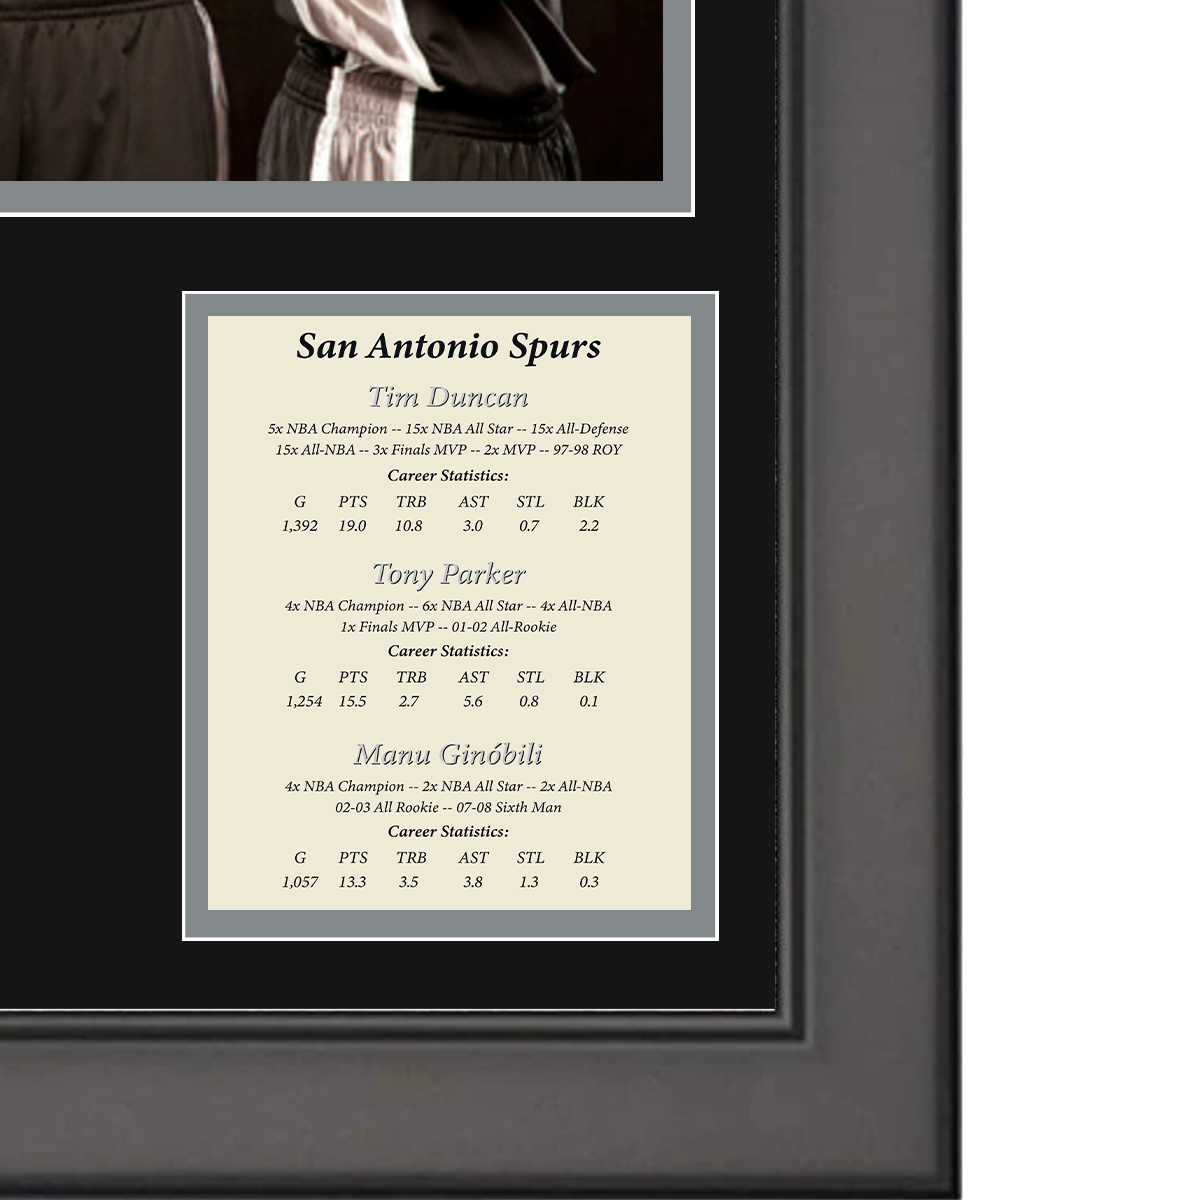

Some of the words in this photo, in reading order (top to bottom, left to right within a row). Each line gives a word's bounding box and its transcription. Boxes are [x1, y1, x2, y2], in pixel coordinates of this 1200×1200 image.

[296, 331, 359, 360] San
[363, 332, 499, 359] Antonio
[508, 331, 602, 368] Spurs
[369, 385, 420, 408] Tim
[426, 386, 529, 409] Duncan
[267, 423, 284, 436] 5x
[285, 422, 318, 435] NBA
[321, 421, 388, 439] Champion
[405, 423, 429, 436] 15x
[430, 422, 463, 435] NBA
[464, 421, 485, 435] All
[486, 422, 515, 435] Star
[530, 423, 554, 436] 15x
[555, 421, 630, 439] All-Defense
[275, 444, 299, 456] 15x
[300, 442, 356, 457] All-NBA
[372, 443, 389, 456] 3x
[390, 442, 431, 456] Finals
[432, 443, 468, 457] MVP
[483, 443, 500, 456] 2x
[501, 443, 537, 457] MVP
[552, 443, 590, 456] 97-98
[591, 443, 624, 457] ROY
[387, 468, 438, 482] Career
[440, 468, 509, 482] Statistics:
[294, 494, 307, 509] G
[337, 494, 368, 509] PTS
[396, 495, 427, 508] TRB
[457, 494, 490, 509] AST
[516, 494, 546, 509] STL
[572, 495, 606, 508] BLK
[281, 519, 319, 534] 1,392
[338, 519, 367, 533] 19.0
[394, 519, 423, 533] 10.8
[462, 519, 484, 533] 3.0
[519, 519, 541, 533] 0.7
[578, 519, 600, 532] 2.2
[373, 562, 434, 593] Tony
[440, 561, 527, 585] Parker
[284, 600, 301, 613] 4x
[303, 599, 335, 613] NBA
[337, 598, 405, 616] Champion
[422, 600, 438, 612] 6x
[440, 599, 473, 613] NBA
[473, 598, 494, 612] All
[496, 599, 524, 612] Star
[539, 600, 556, 612] 4x
[557, 598, 613, 613] All-NBA
[340, 621, 357, 634] 1x
[358, 620, 399, 633] Finals
[400, 620, 436, 634] MVP
[451, 620, 488, 634] 01-02
[489, 619, 557, 634] All-Rookie
[387, 644, 438, 658] Career
[440, 644, 509, 658] Statistics:
[294, 670, 307, 684] G
[338, 670, 369, 684] PTS
[396, 670, 427, 684] TRB
[457, 670, 490, 684] AST
[516, 670, 546, 684] STL
[572, 670, 607, 684] BLK
[286, 694, 323, 709] 1,254
[338, 695, 367, 708] 15.5
[398, 694, 420, 708] 2.7
[462, 694, 484, 709] 5.6
[519, 694, 540, 708] 0.8
[579, 694, 598, 708] 0.1
[352, 743, 431, 766] Manu
[439, 741, 543, 766] Ginóbili
[284, 780, 301, 793] 4x
[303, 780, 335, 793] NBA
[337, 779, 405, 796] Champion
[421, 780, 438, 792] 2x
[440, 780, 473, 793] NBA
[473, 779, 494, 793] All
[496, 779, 524, 793] Star
[539, 780, 556, 793] 2x
[557, 779, 613, 793] All-NBA
[335, 801, 371, 814] 02-03
[372, 800, 394, 814] All
[395, 800, 440, 814] Rookie
[456, 801, 492, 814] 07-08
[494, 800, 528, 814] Sixth
[530, 801, 562, 814] Man
[387, 824, 438, 838] Career
[440, 824, 509, 838] Statistics:
[294, 850, 307, 865] G
[338, 850, 369, 865] PTS
[396, 851, 427, 864] TRB
[457, 850, 490, 865] AST
[516, 850, 546, 865] STL
[572, 851, 607, 864] BLK
[282, 875, 320, 890] 1,057
[338, 875, 367, 889] 13.3
[398, 875, 419, 889] 3.5
[462, 875, 484, 889] 3.8
[519, 875, 539, 889] 1.3
[579, 875, 599, 889] 0.3
